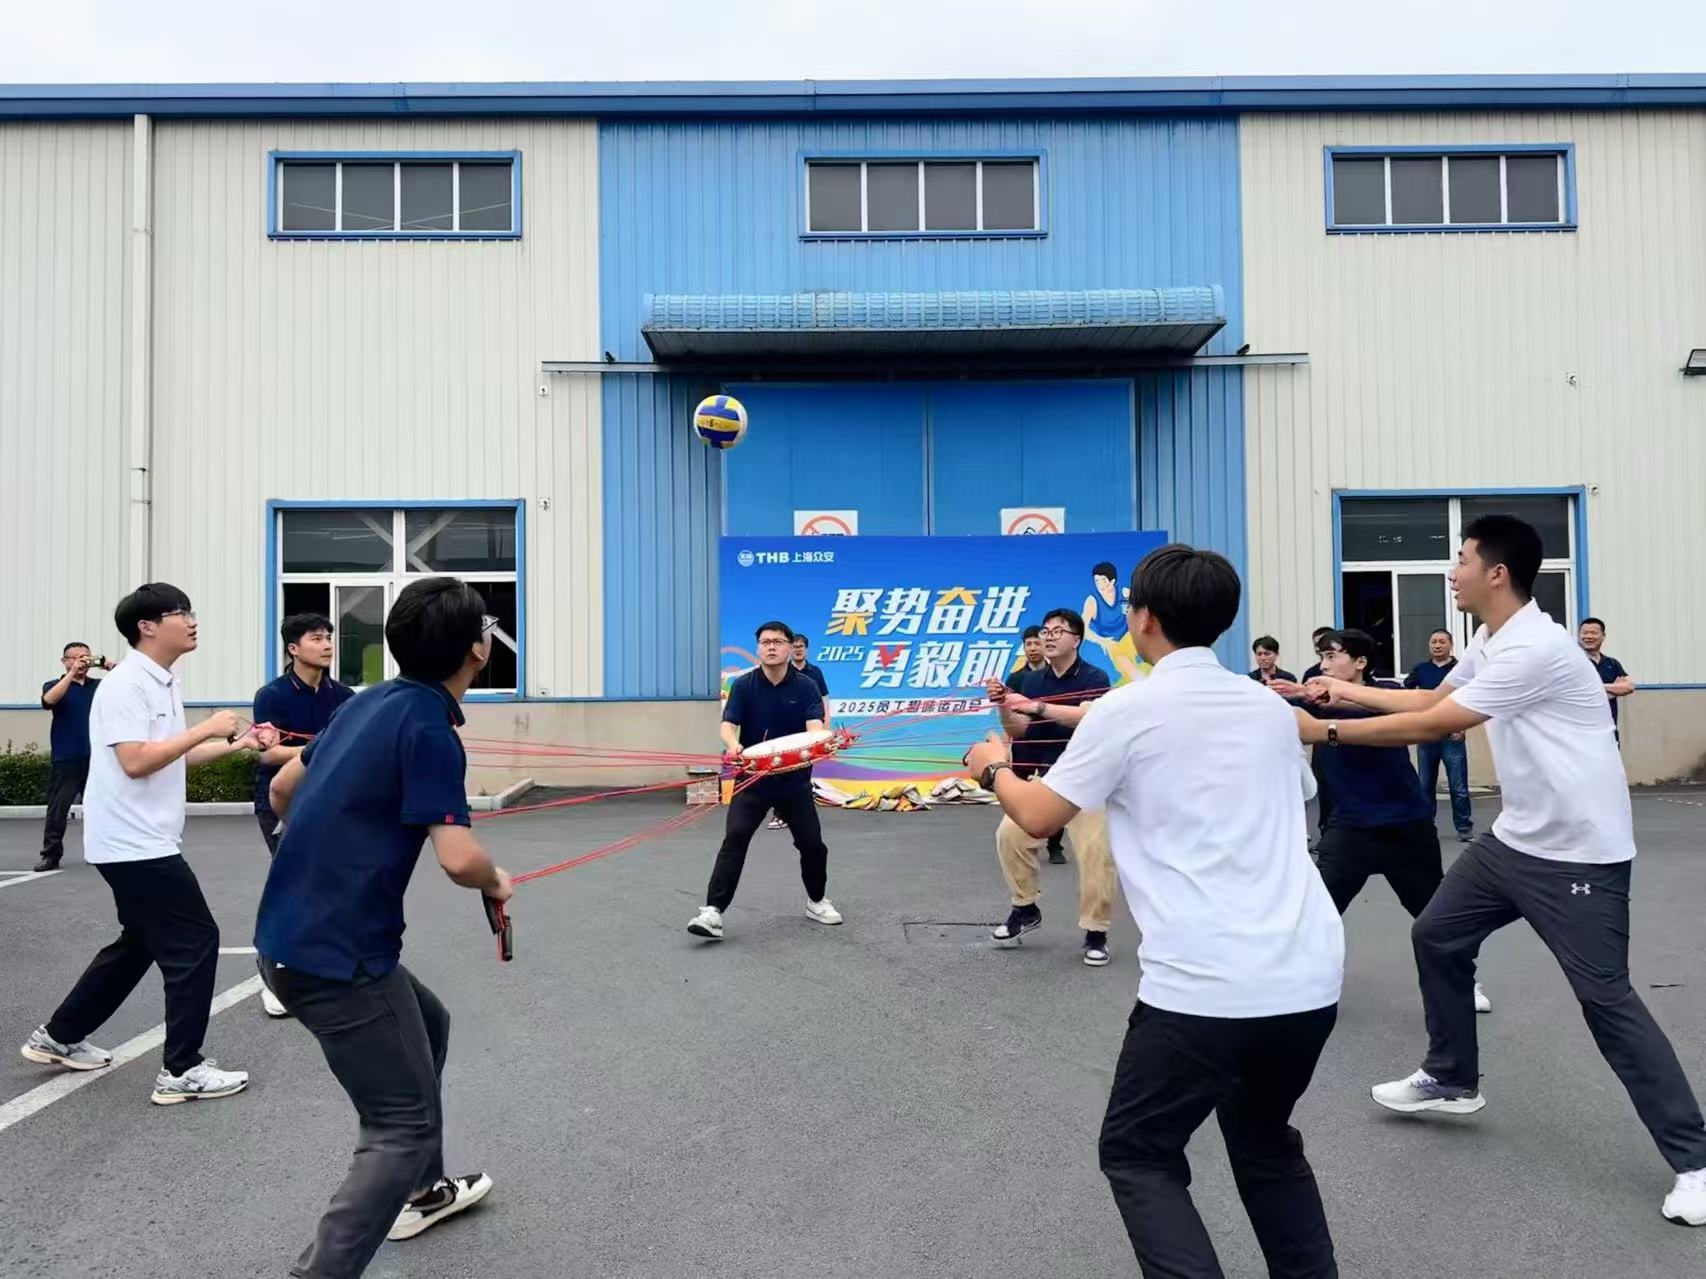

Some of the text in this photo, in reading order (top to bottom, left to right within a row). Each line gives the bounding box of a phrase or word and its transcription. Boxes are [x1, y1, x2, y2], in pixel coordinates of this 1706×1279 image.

[756, 551, 790, 563] THB
[824, 586, 1031, 635] 聚势奋进
[816, 640, 1028, 689] 2025 勇毅前
